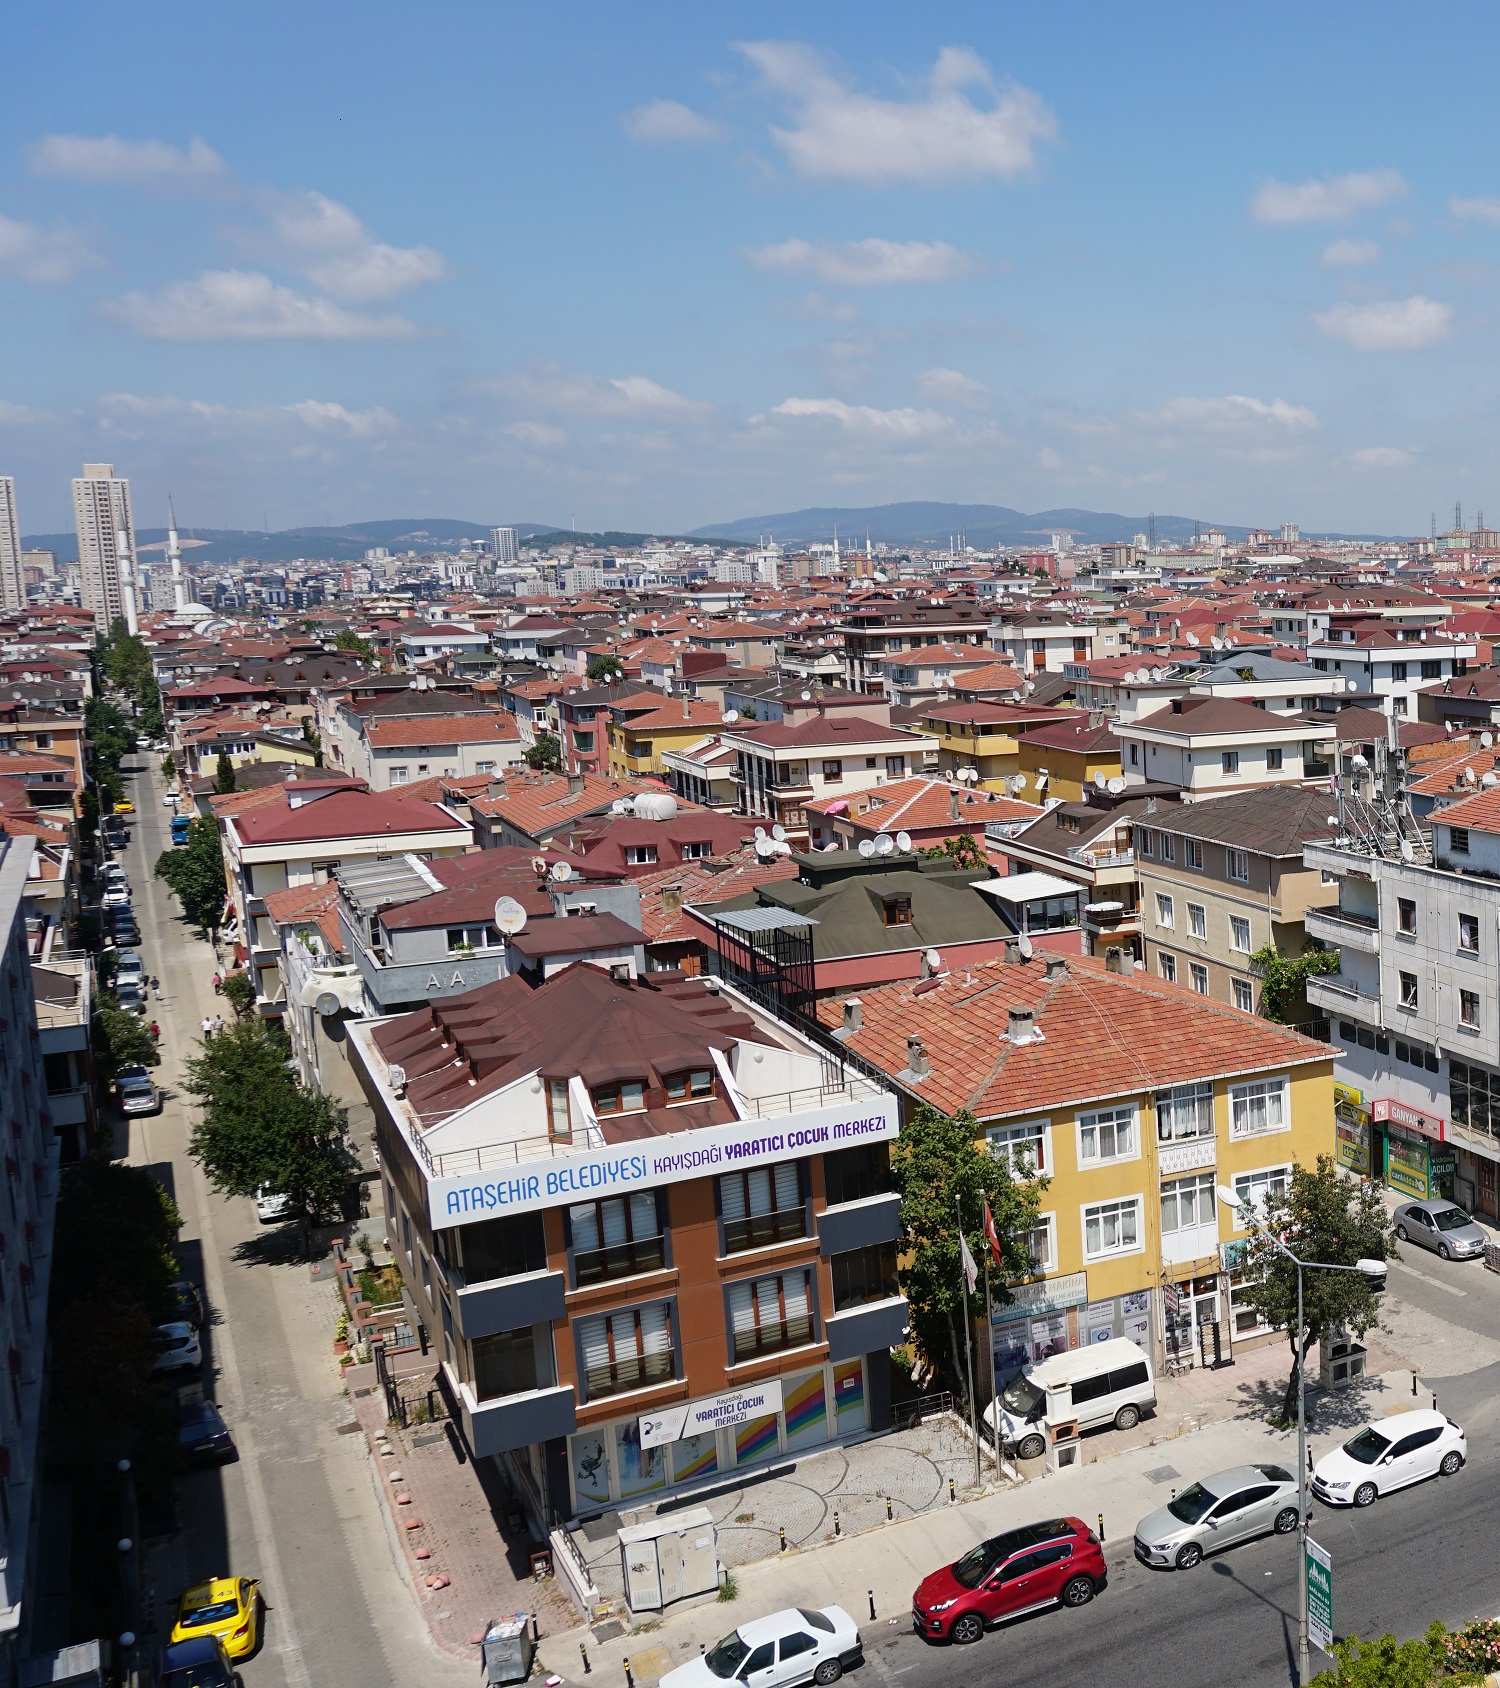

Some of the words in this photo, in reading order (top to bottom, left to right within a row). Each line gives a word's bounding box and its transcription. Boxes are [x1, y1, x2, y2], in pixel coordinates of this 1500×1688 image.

[1391, 1106, 1419, 1127] GANYAN
[446, 1176, 540, 1214] ATAŞEHİR
[546, 1155, 647, 1195] BELEDİYESİ
[653, 1144, 722, 1174] KAYIŞDAĞI
[724, 1135, 784, 1160] YARATICI
[787, 1126, 829, 1149] ÇOCUK
[833, 1116, 886, 1139] MERKEZİ
[1049, 1277, 1085, 1292] MAKİNA
[695, 1403, 735, 1422] YARATICI
[737, 1395, 764, 1412] ÇOCUK
[716, 1393, 744, 1406] Kayışdağı
